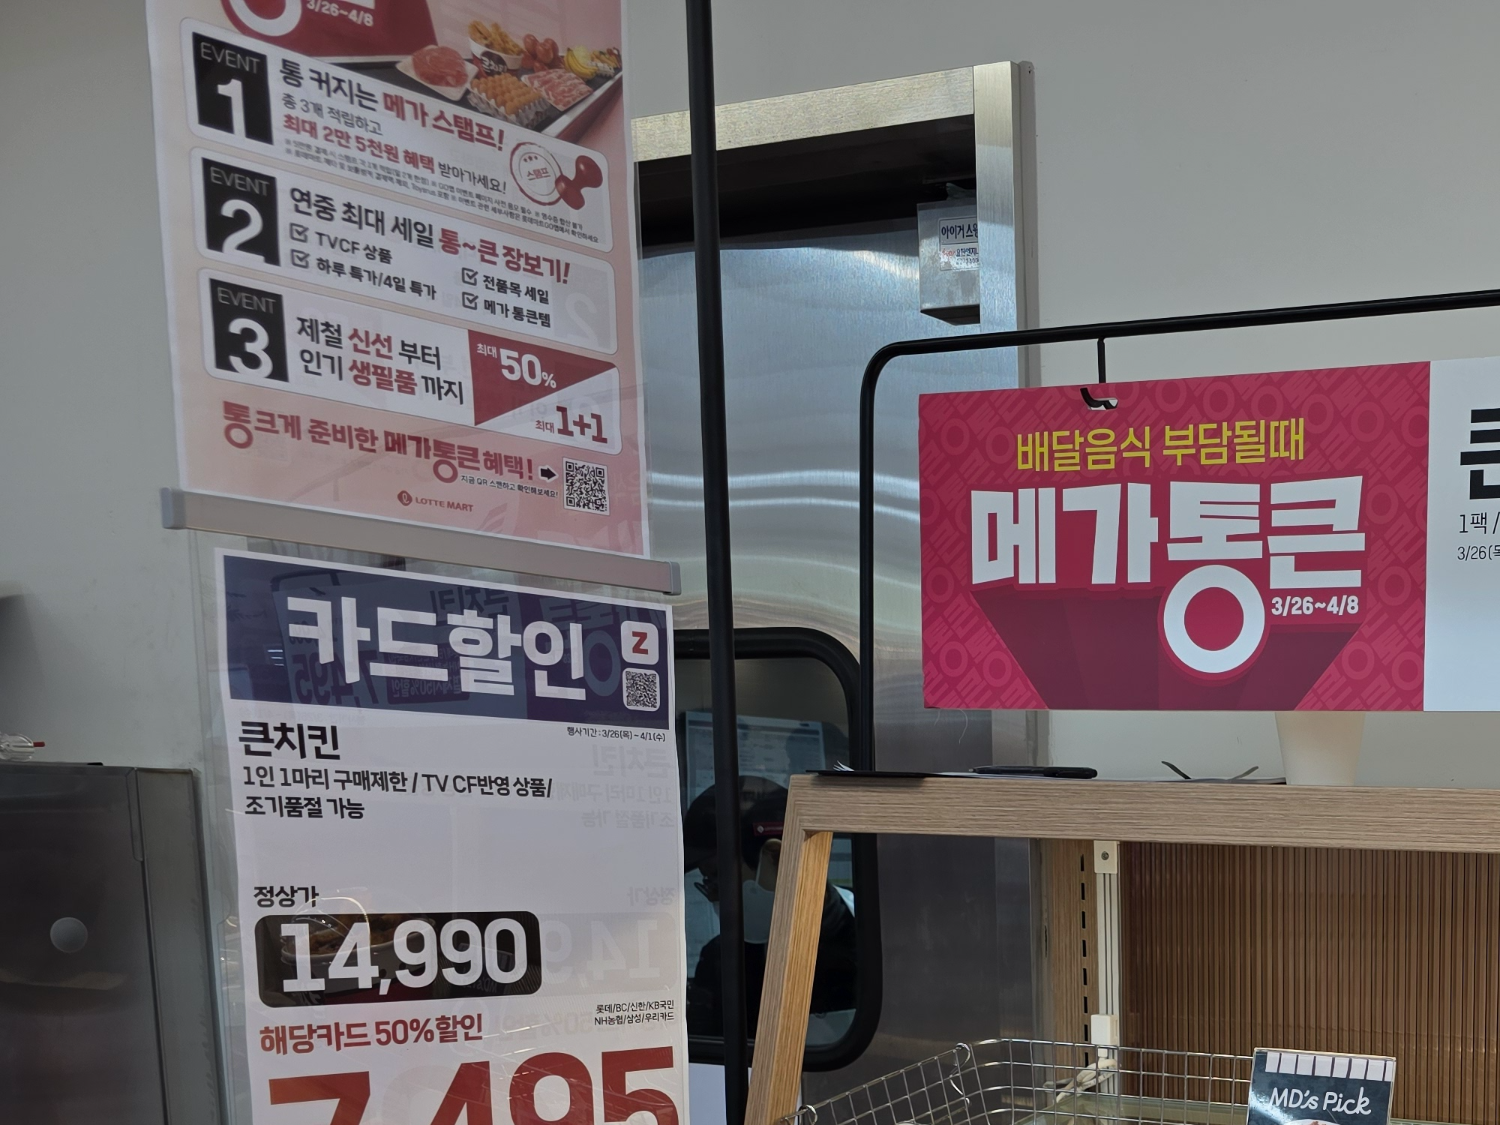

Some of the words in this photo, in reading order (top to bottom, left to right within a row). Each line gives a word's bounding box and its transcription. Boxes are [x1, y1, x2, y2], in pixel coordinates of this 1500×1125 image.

[200, 42, 261, 74] EVENT
[217, 78, 247, 141] 1
[279, 58, 304, 87] 통
[308, 66, 379, 111] 커지는
[383, 93, 428, 129] 메가
[432, 112, 506, 151] 스탬프!
[283, 93, 297, 110] 총
[300, 97, 323, 117] 3개
[326, 104, 384, 136] 적립하고
[283, 114, 319, 139] 최대
[322, 125, 353, 150] 2만
[355, 135, 401, 163] 5천원
[403, 149, 436, 174] 혜택
[438, 161, 507, 195] 받아가세요!
[210, 167, 270, 196] EVENT
[526, 167, 551, 181] 스탬프
[220, 198, 266, 264] 2
[289, 186, 337, 222] 연중
[341, 201, 386, 236] 최대
[391, 219, 434, 249] 세일
[438, 227, 499, 264] 통~큰
[501, 246, 570, 284] 장보기!
[315, 231, 362, 257] TVCF
[363, 245, 393, 265] 상품
[315, 258, 347, 279] 하루
[349, 265, 407, 294] 특가/4일
[409, 279, 437, 301] 특가
[482, 273, 522, 299] 전품목
[523, 284, 550, 305] 세일
[216, 286, 276, 315] EVENT
[483, 297, 509, 317] 메가
[512, 304, 552, 329] 통큰템
[226, 318, 273, 377] 3
[297, 315, 343, 350] 제철
[348, 328, 394, 361] 신선
[398, 340, 442, 371] 부터
[299, 347, 343, 381] 인기
[348, 359, 418, 397] 생필품
[421, 373, 465, 405] 까지
[476, 342, 498, 359] 최대
[499, 348, 557, 390] 50%
[223, 400, 302, 449] 통크게
[307, 418, 379, 453] 준비한
[384, 430, 481, 484] 메가통큰
[483, 448, 534, 482] 혜택!
[534, 419, 555, 433] 최대
[556, 405, 608, 443] 1+1
[1017, 425, 1151, 472] 배달음식
[1163, 418, 1305, 466] 부담될때
[415, 495, 445, 508] LOTTE
[447, 500, 474, 513] MART
[460, 474, 475, 485] 지금
[476, 477, 488, 487] QR
[488, 479, 516, 492] 스캔하고
[517, 484, 559, 498] 확인해보세요!
[1458, 511, 1488, 535] 1팩
[970, 475, 1366, 674] 메가통큰
[1271, 595, 1360, 617] 3/26~4/8
[287, 596, 586, 701] 카드할인
[632, 631, 649, 655] Z
[239, 721, 341, 760] 큰치킨
[243, 766, 276, 787] 1인
[280, 767, 329, 790] 1마리
[333, 769, 408, 793] 구매제한
[421, 774, 448, 791] TV
[453, 775, 511, 797] CF반영
[245, 797, 323, 819] 조기품절
[327, 798, 365, 820] 가능
[253, 886, 319, 908] 정상가
[281, 918, 528, 996] 14,990
[259, 1020, 371, 1055] 해당카드
[1268, 1087, 1320, 1111] MD's
[1322, 1087, 1372, 1116] Pick
